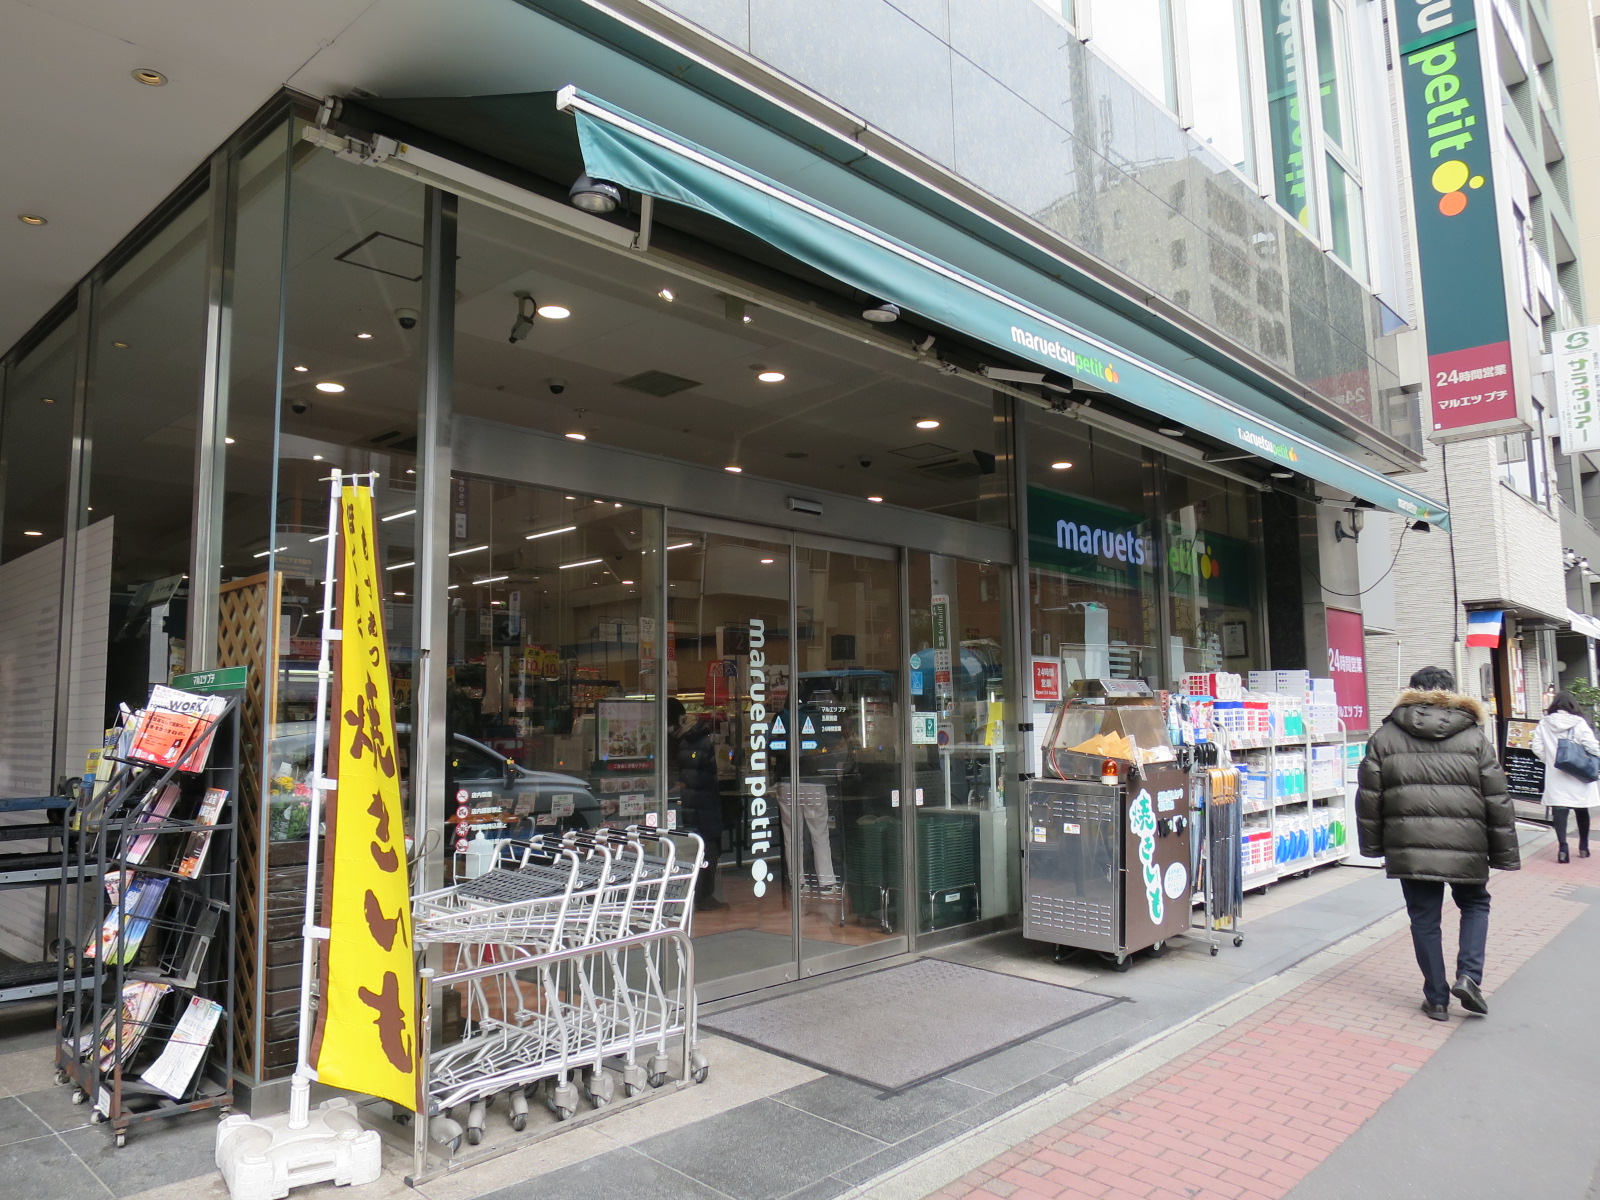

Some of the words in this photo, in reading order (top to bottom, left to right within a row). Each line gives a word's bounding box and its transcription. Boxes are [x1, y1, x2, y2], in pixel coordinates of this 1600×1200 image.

[1416, 0, 1453, 33] u
[1408, 41, 1476, 158] petit
[1010, 326, 1105, 379] maruetsupetit
[1436, 364, 1507, 387] 24時間営業
[1438, 395, 1482, 410] マルエツ
[1484, 390, 1508, 402] プチ
[1328, 648, 1363, 673] 24時間営業
[170, 700, 203, 712] WORK
[745, 618, 772, 855] maruetsupetit
[1132, 794, 1163, 920] 焼きいも
